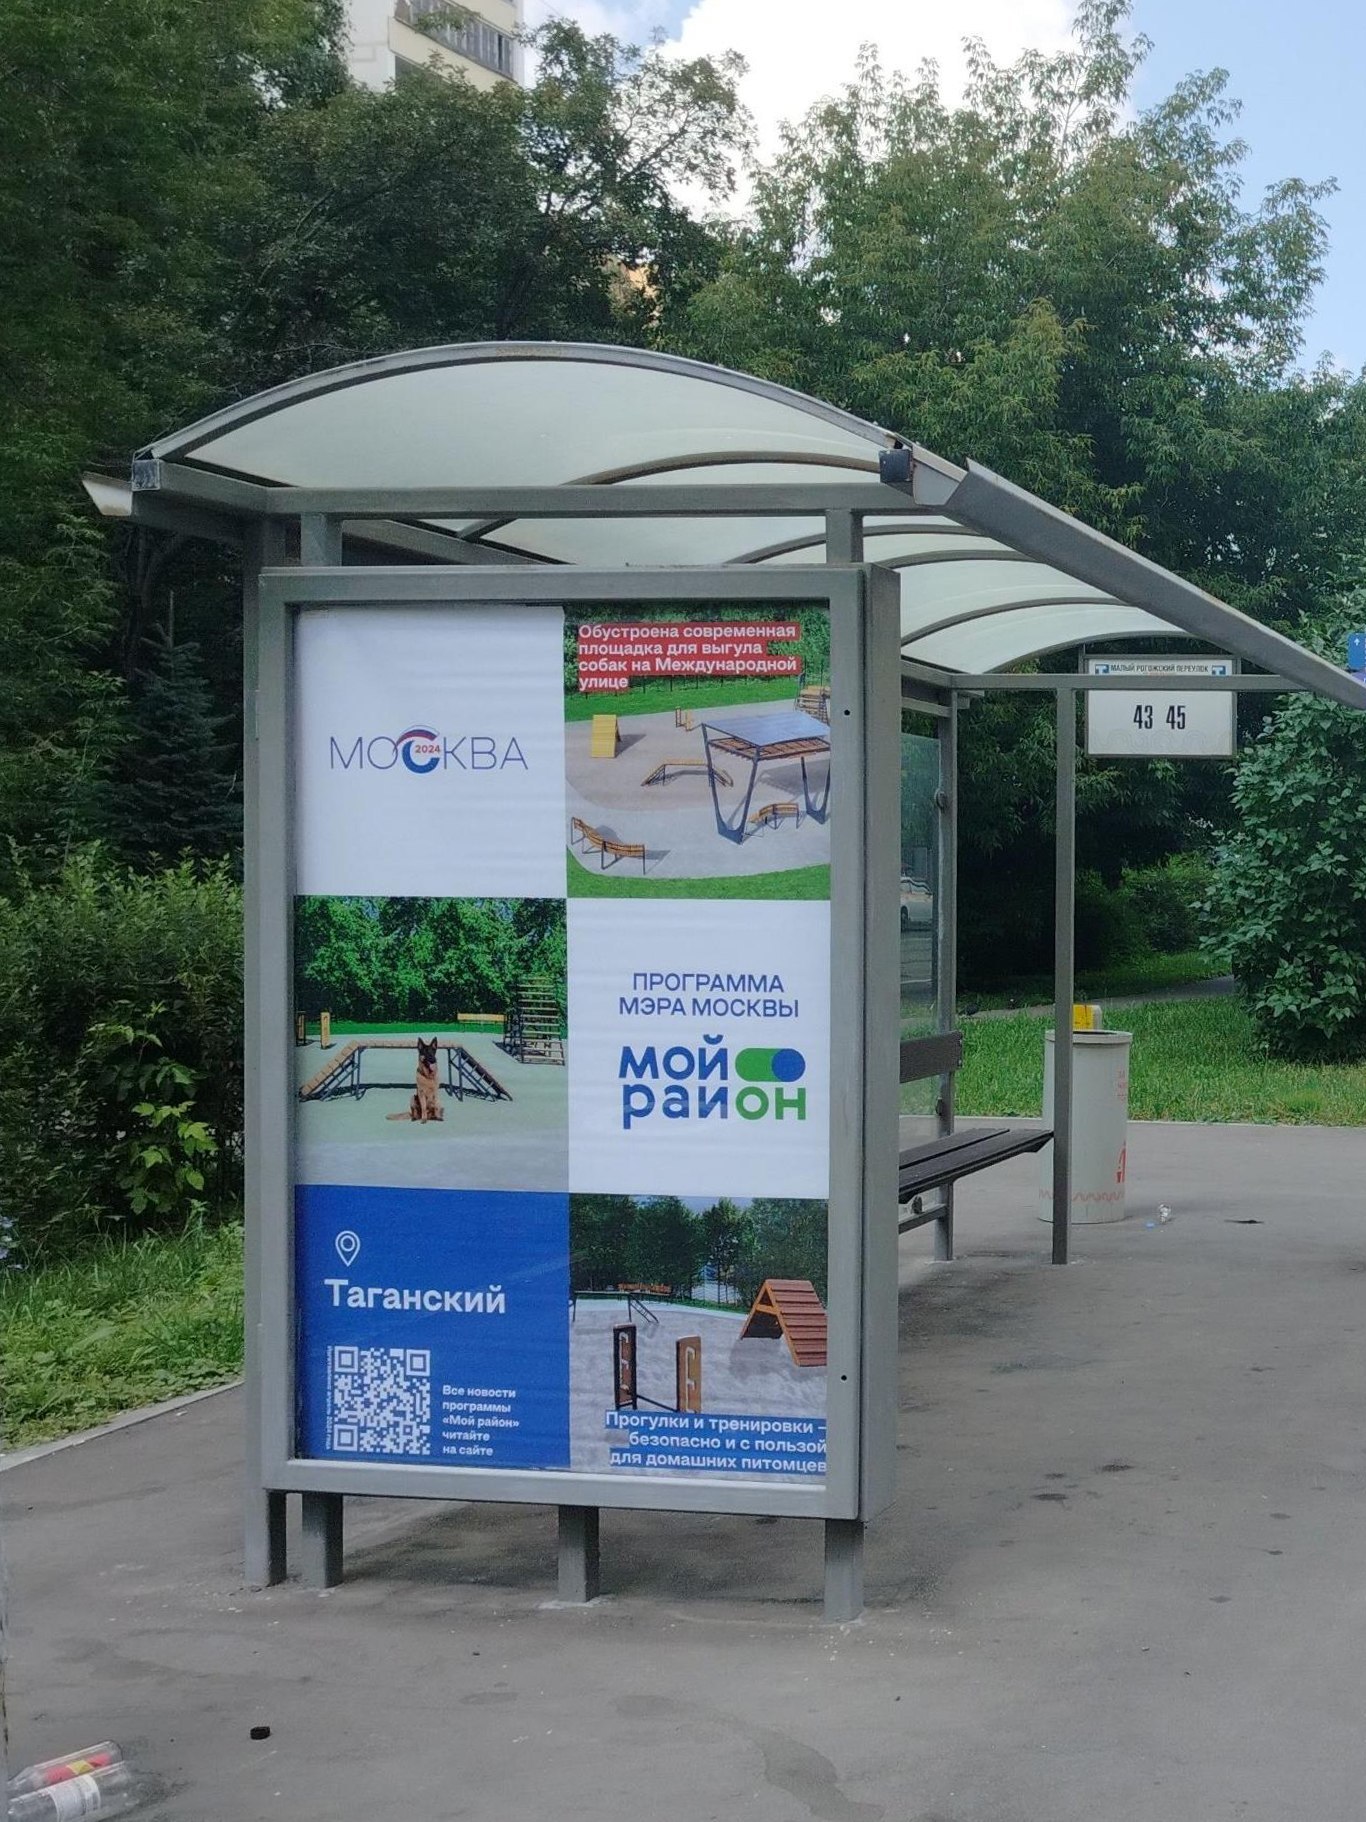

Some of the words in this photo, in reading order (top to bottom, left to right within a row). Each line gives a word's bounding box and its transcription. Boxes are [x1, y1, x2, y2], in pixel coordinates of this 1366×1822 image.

[578, 625, 680, 641] Обустроена
[683, 626, 796, 640] современная
[578, 644, 663, 657] площадка
[666, 644, 698, 656] для
[702, 644, 763, 660] выгула
[578, 657, 628, 672] собак
[631, 661, 651, 672] на
[655, 657, 798, 674] Международной
[1110, 663, 1134, 672] МАЛЫЙ
[1176, 664, 1209, 672] ПЕРЕУЛОК
[578, 676, 630, 692] улице
[1133, 704, 1154, 730] 43
[1166, 705, 1187, 730] 45
[330, 727, 529, 774] МОСКВА
[414, 744, 440, 754] 2024
[632, 972, 784, 993] ПРОГРАММА
[618, 996, 686, 1016] МЭРА
[692, 998, 800, 1018] МОСКВЫ
[324, 1278, 506, 1314] Таганский
[442, 1384, 465, 1396] Все
[467, 1388, 516, 1398] новости
[442, 1402, 512, 1414] программы
[442, 1414, 475, 1426] «Мой
[477, 1416, 520, 1428] район»
[606, 1410, 690, 1429] Прогулки
[693, 1418, 704, 1429] и
[708, 1418, 814, 1434] тренировки
[442, 1430, 490, 1442] читайте
[628, 1431, 721, 1449] безопасно
[724, 1439, 736, 1449] и
[740, 1440, 750, 1450] с
[754, 1439, 827, 1453] пользой
[442, 1446, 457, 1454] на
[458, 1444, 494, 1456] сайте
[610, 1452, 642, 1464] для
[646, 1453, 738, 1469] домашних
[742, 1457, 827, 1473] питомцев
